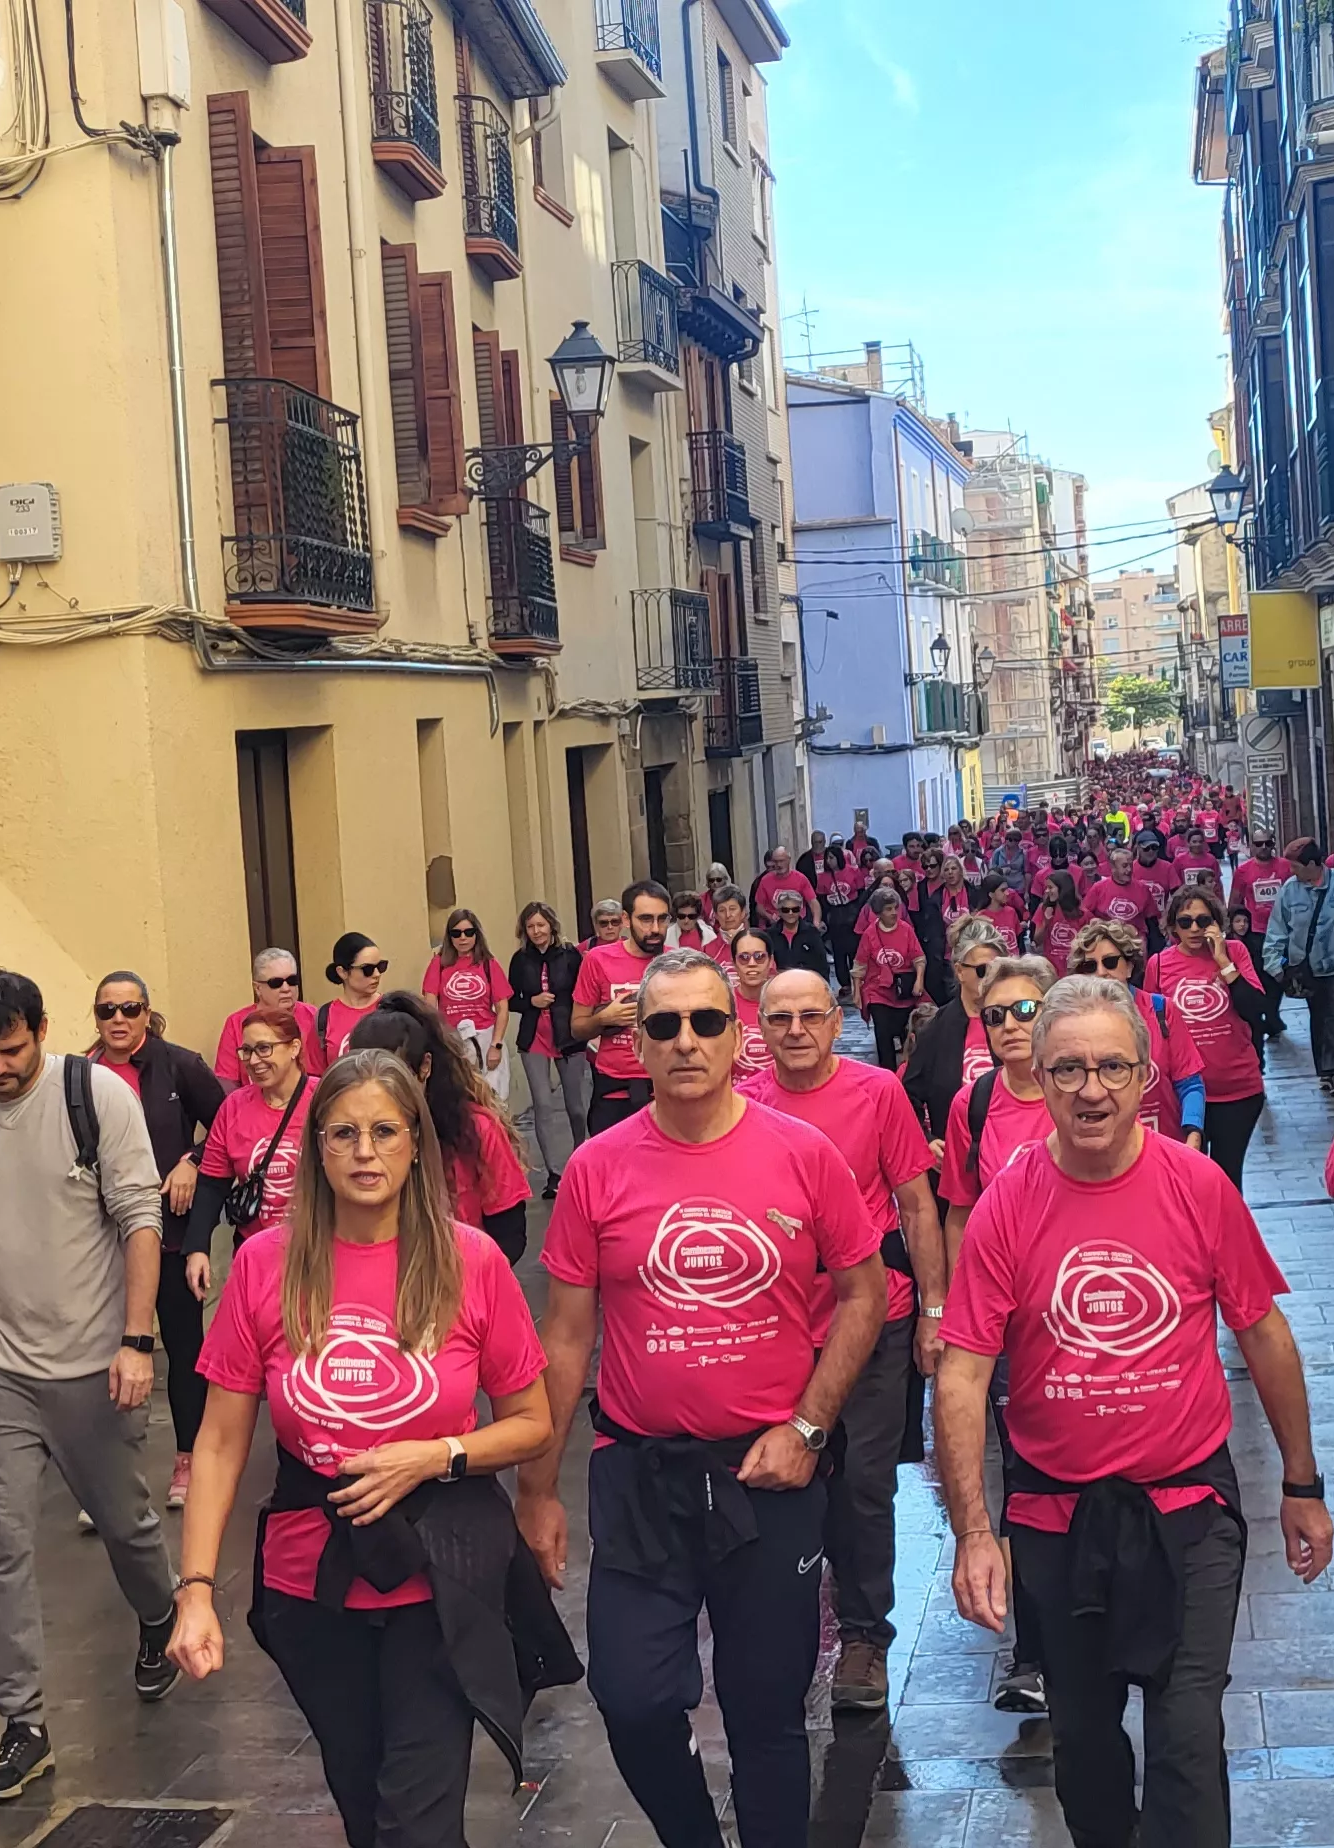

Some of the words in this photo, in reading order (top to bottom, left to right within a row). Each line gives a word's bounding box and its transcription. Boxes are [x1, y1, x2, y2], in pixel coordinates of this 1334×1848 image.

[1288, 658, 1316, 670] group
[684, 1255, 723, 1268] JUNTOS
[1087, 1300, 1124, 1314] JUNTOS
[331, 1368, 373, 1382] JUNTOS
